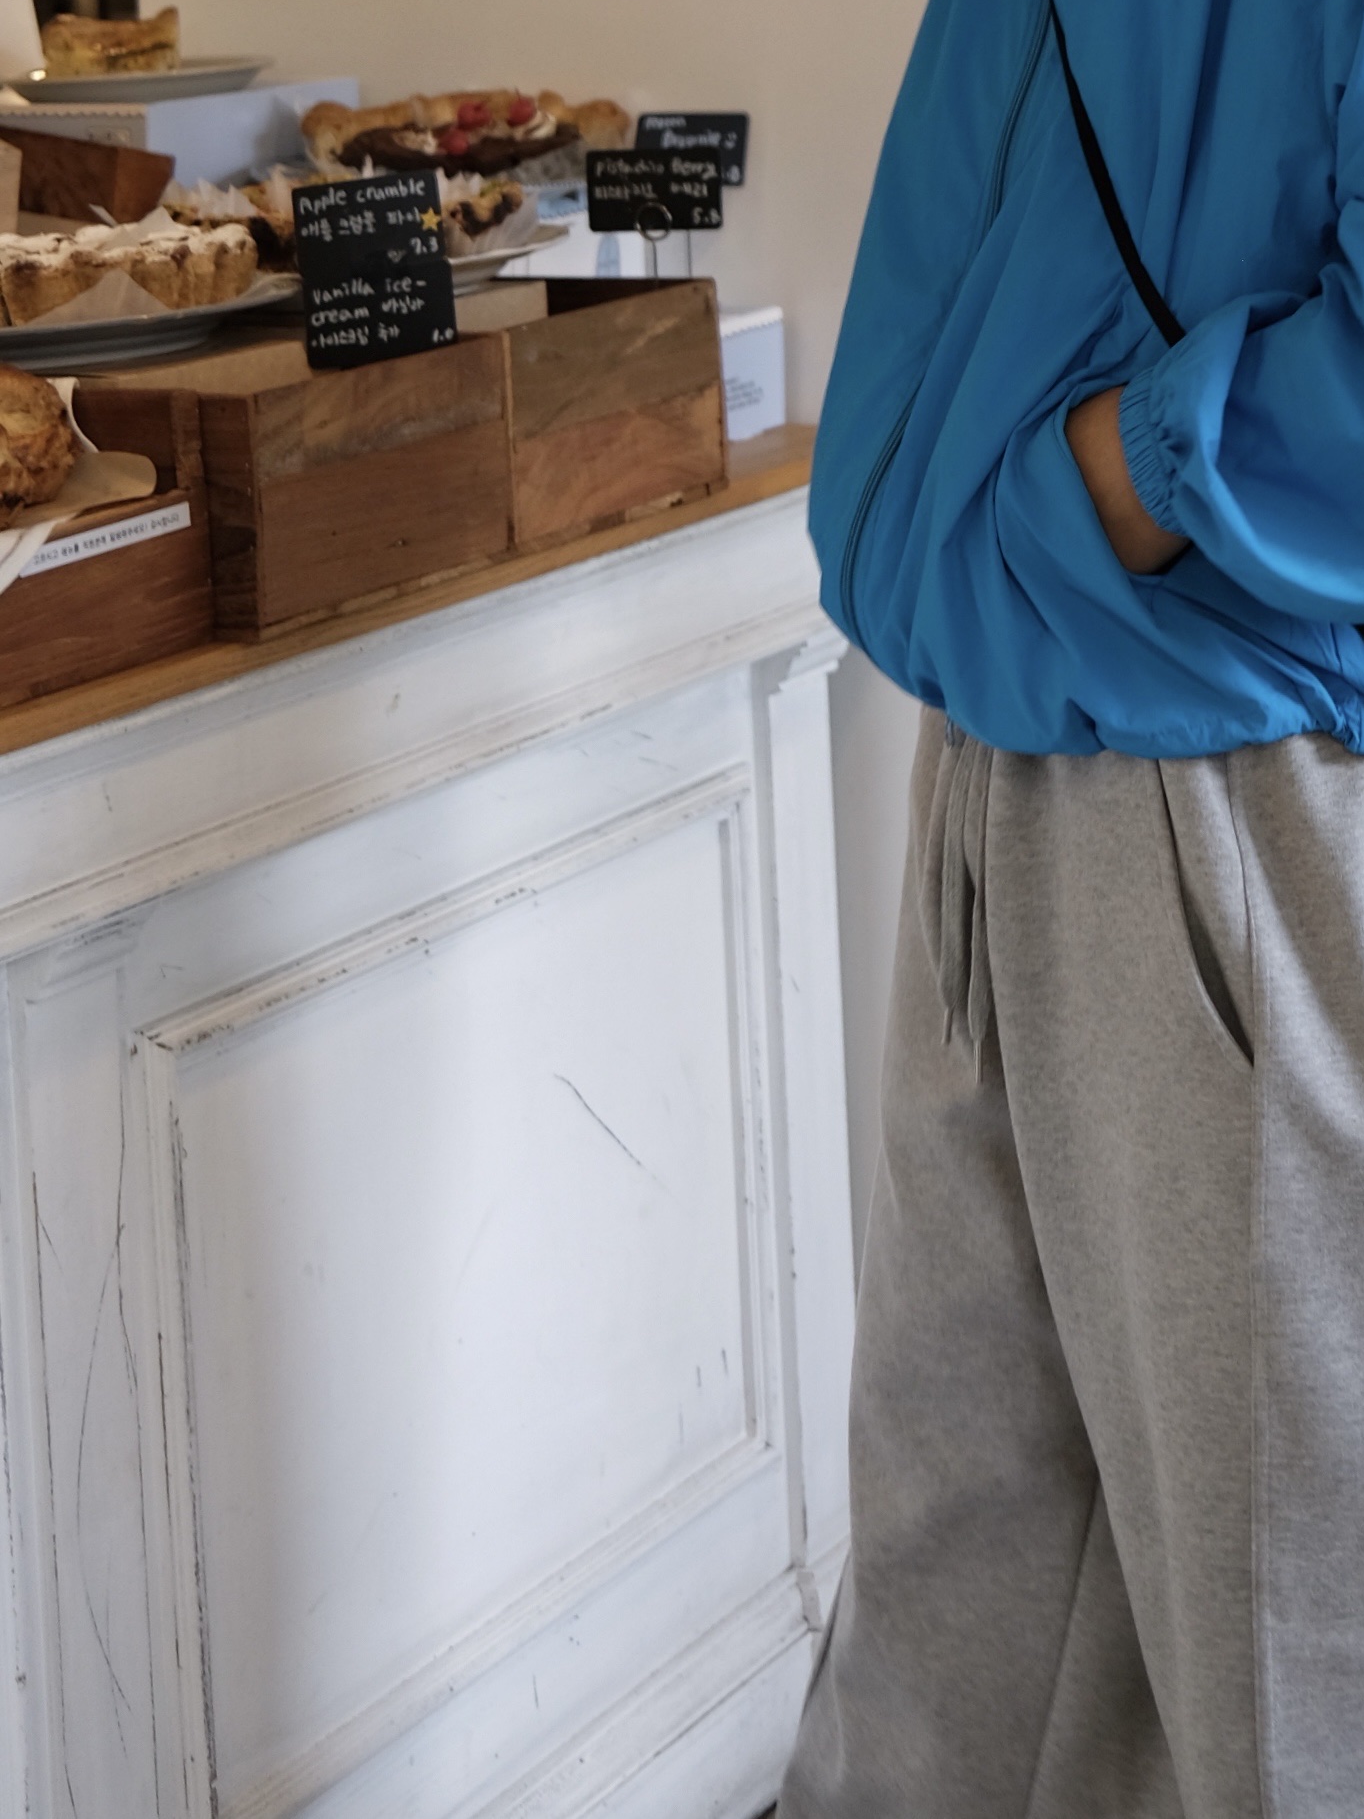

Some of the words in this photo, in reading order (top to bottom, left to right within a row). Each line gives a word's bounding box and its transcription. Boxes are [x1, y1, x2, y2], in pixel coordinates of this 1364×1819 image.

[300, 187, 348, 215] Apple
[356, 178, 425, 202] crumble
[312, 277, 375, 305] Vanilla
[311, 306, 370, 327] cream
